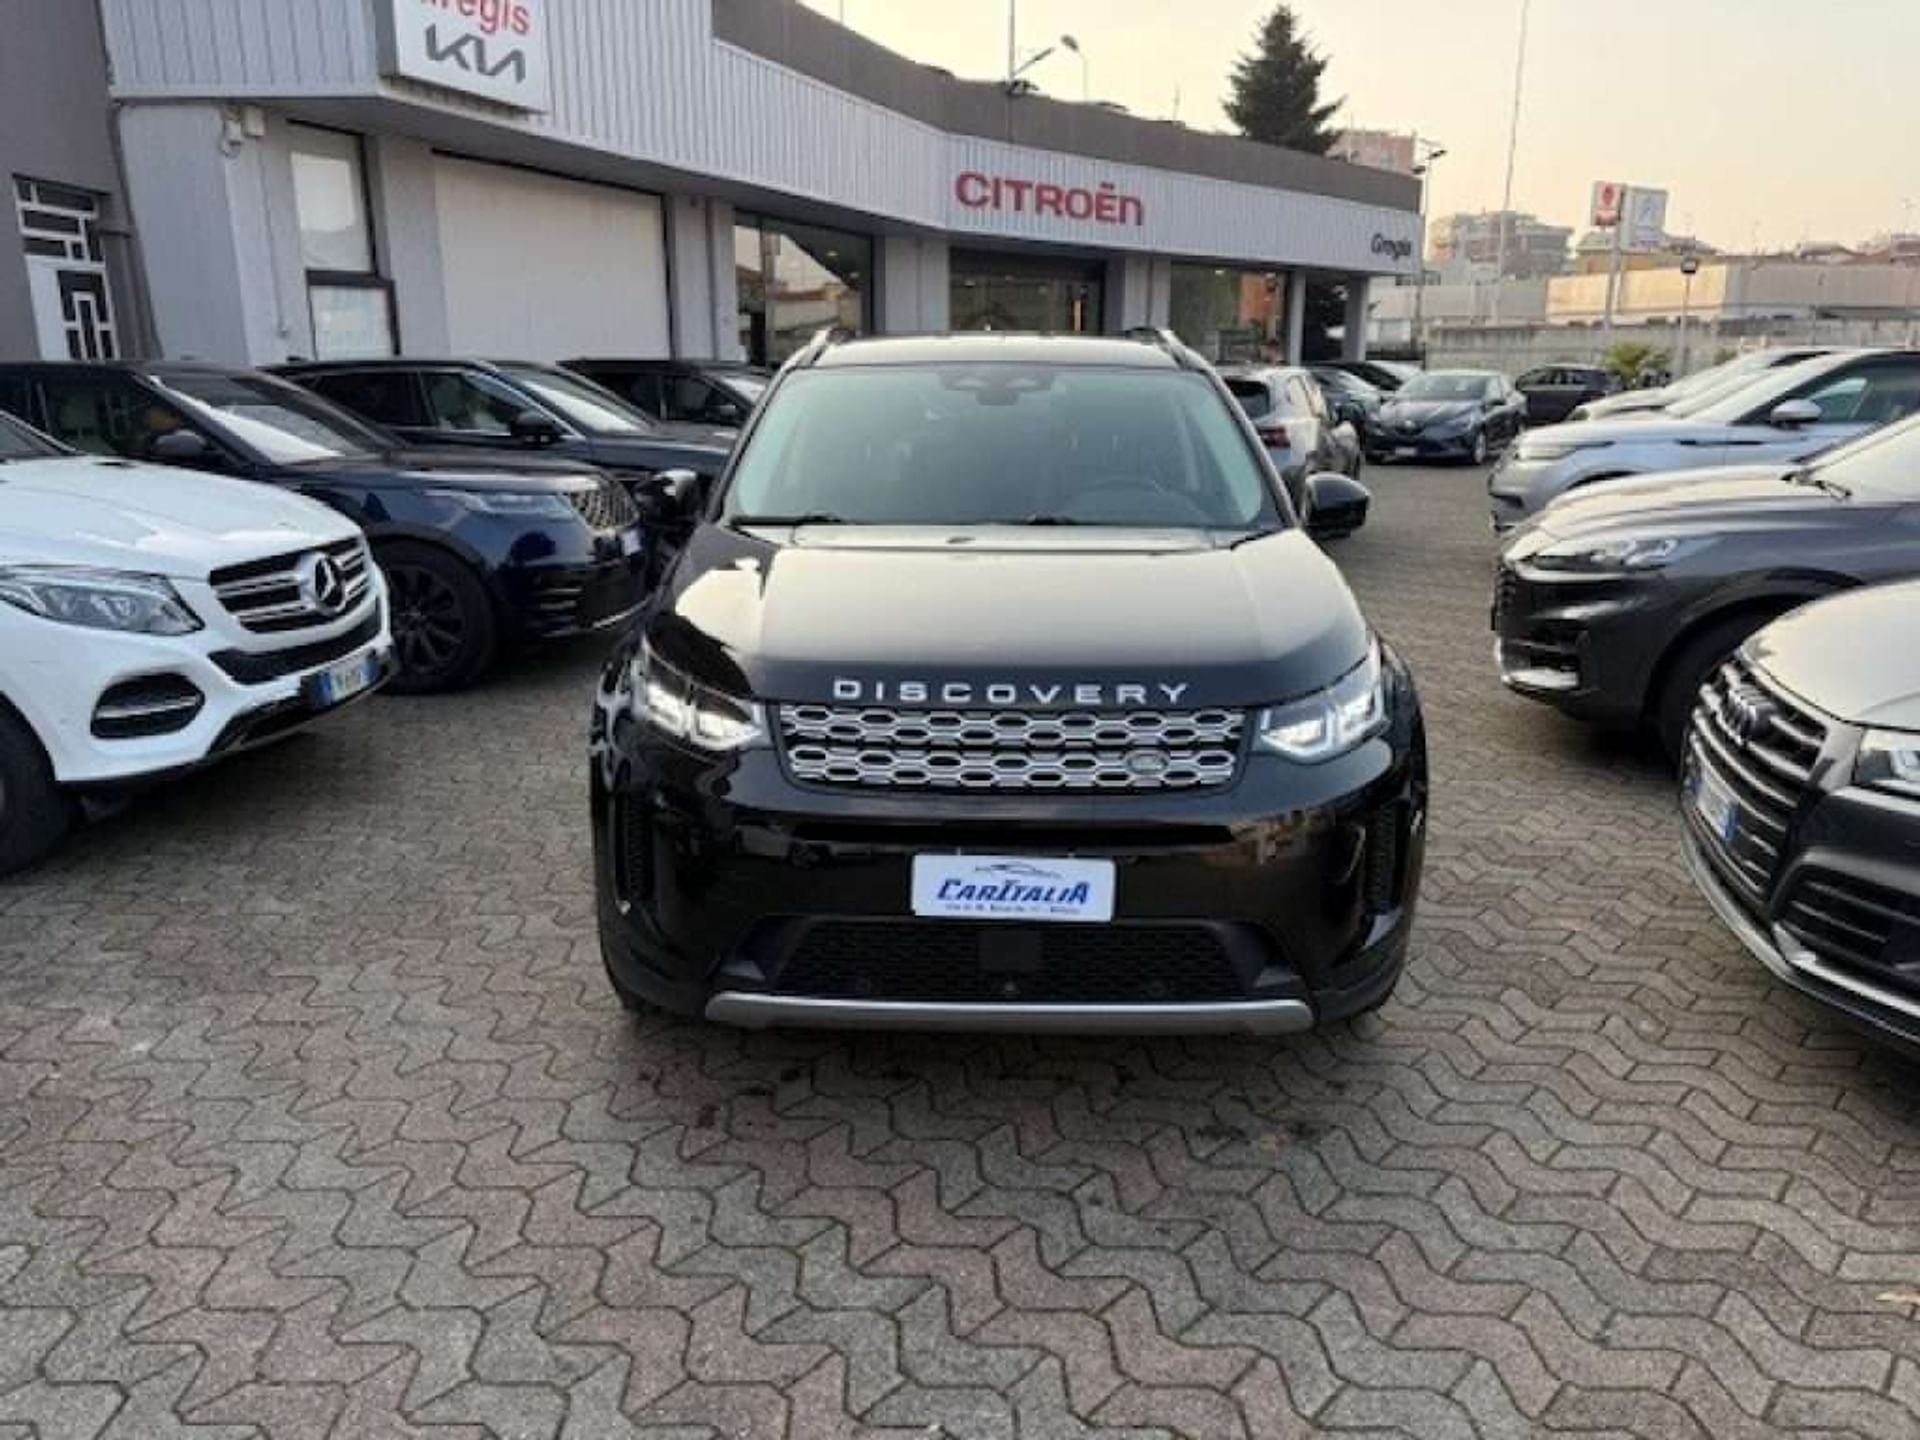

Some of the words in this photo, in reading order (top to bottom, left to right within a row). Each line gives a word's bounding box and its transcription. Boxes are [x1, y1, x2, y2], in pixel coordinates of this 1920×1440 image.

[420, 0, 529, 34] egis
[426, 24, 526, 83] KIA
[833, 680, 1188, 704] DISCOVERY
